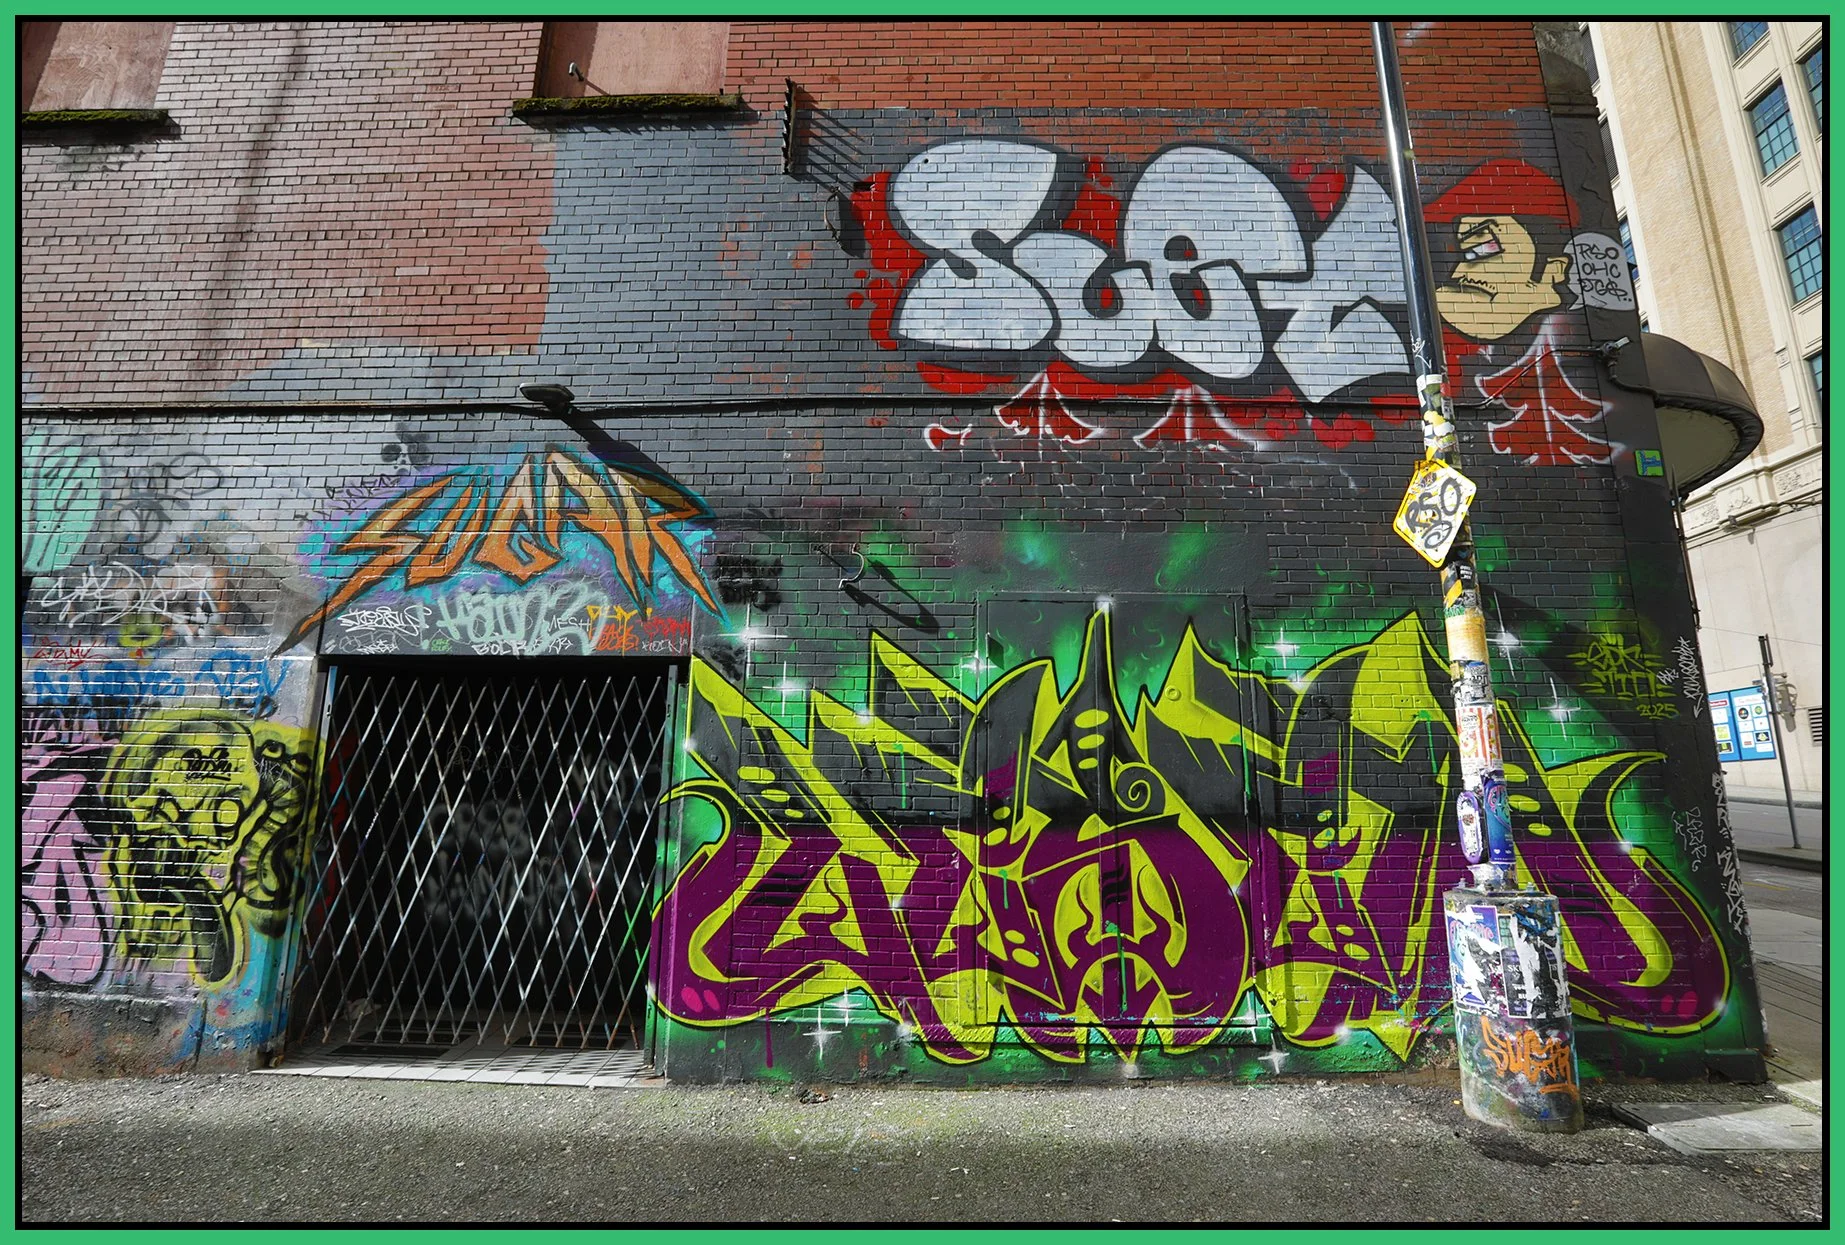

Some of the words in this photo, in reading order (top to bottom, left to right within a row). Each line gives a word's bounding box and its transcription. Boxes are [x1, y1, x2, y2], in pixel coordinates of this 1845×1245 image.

[1575, 242, 1620, 260] RSO
[1581, 261, 1621, 279] OHC
[278, 443, 728, 656] SUGAR
[1636, 703, 1681, 719] 2025
